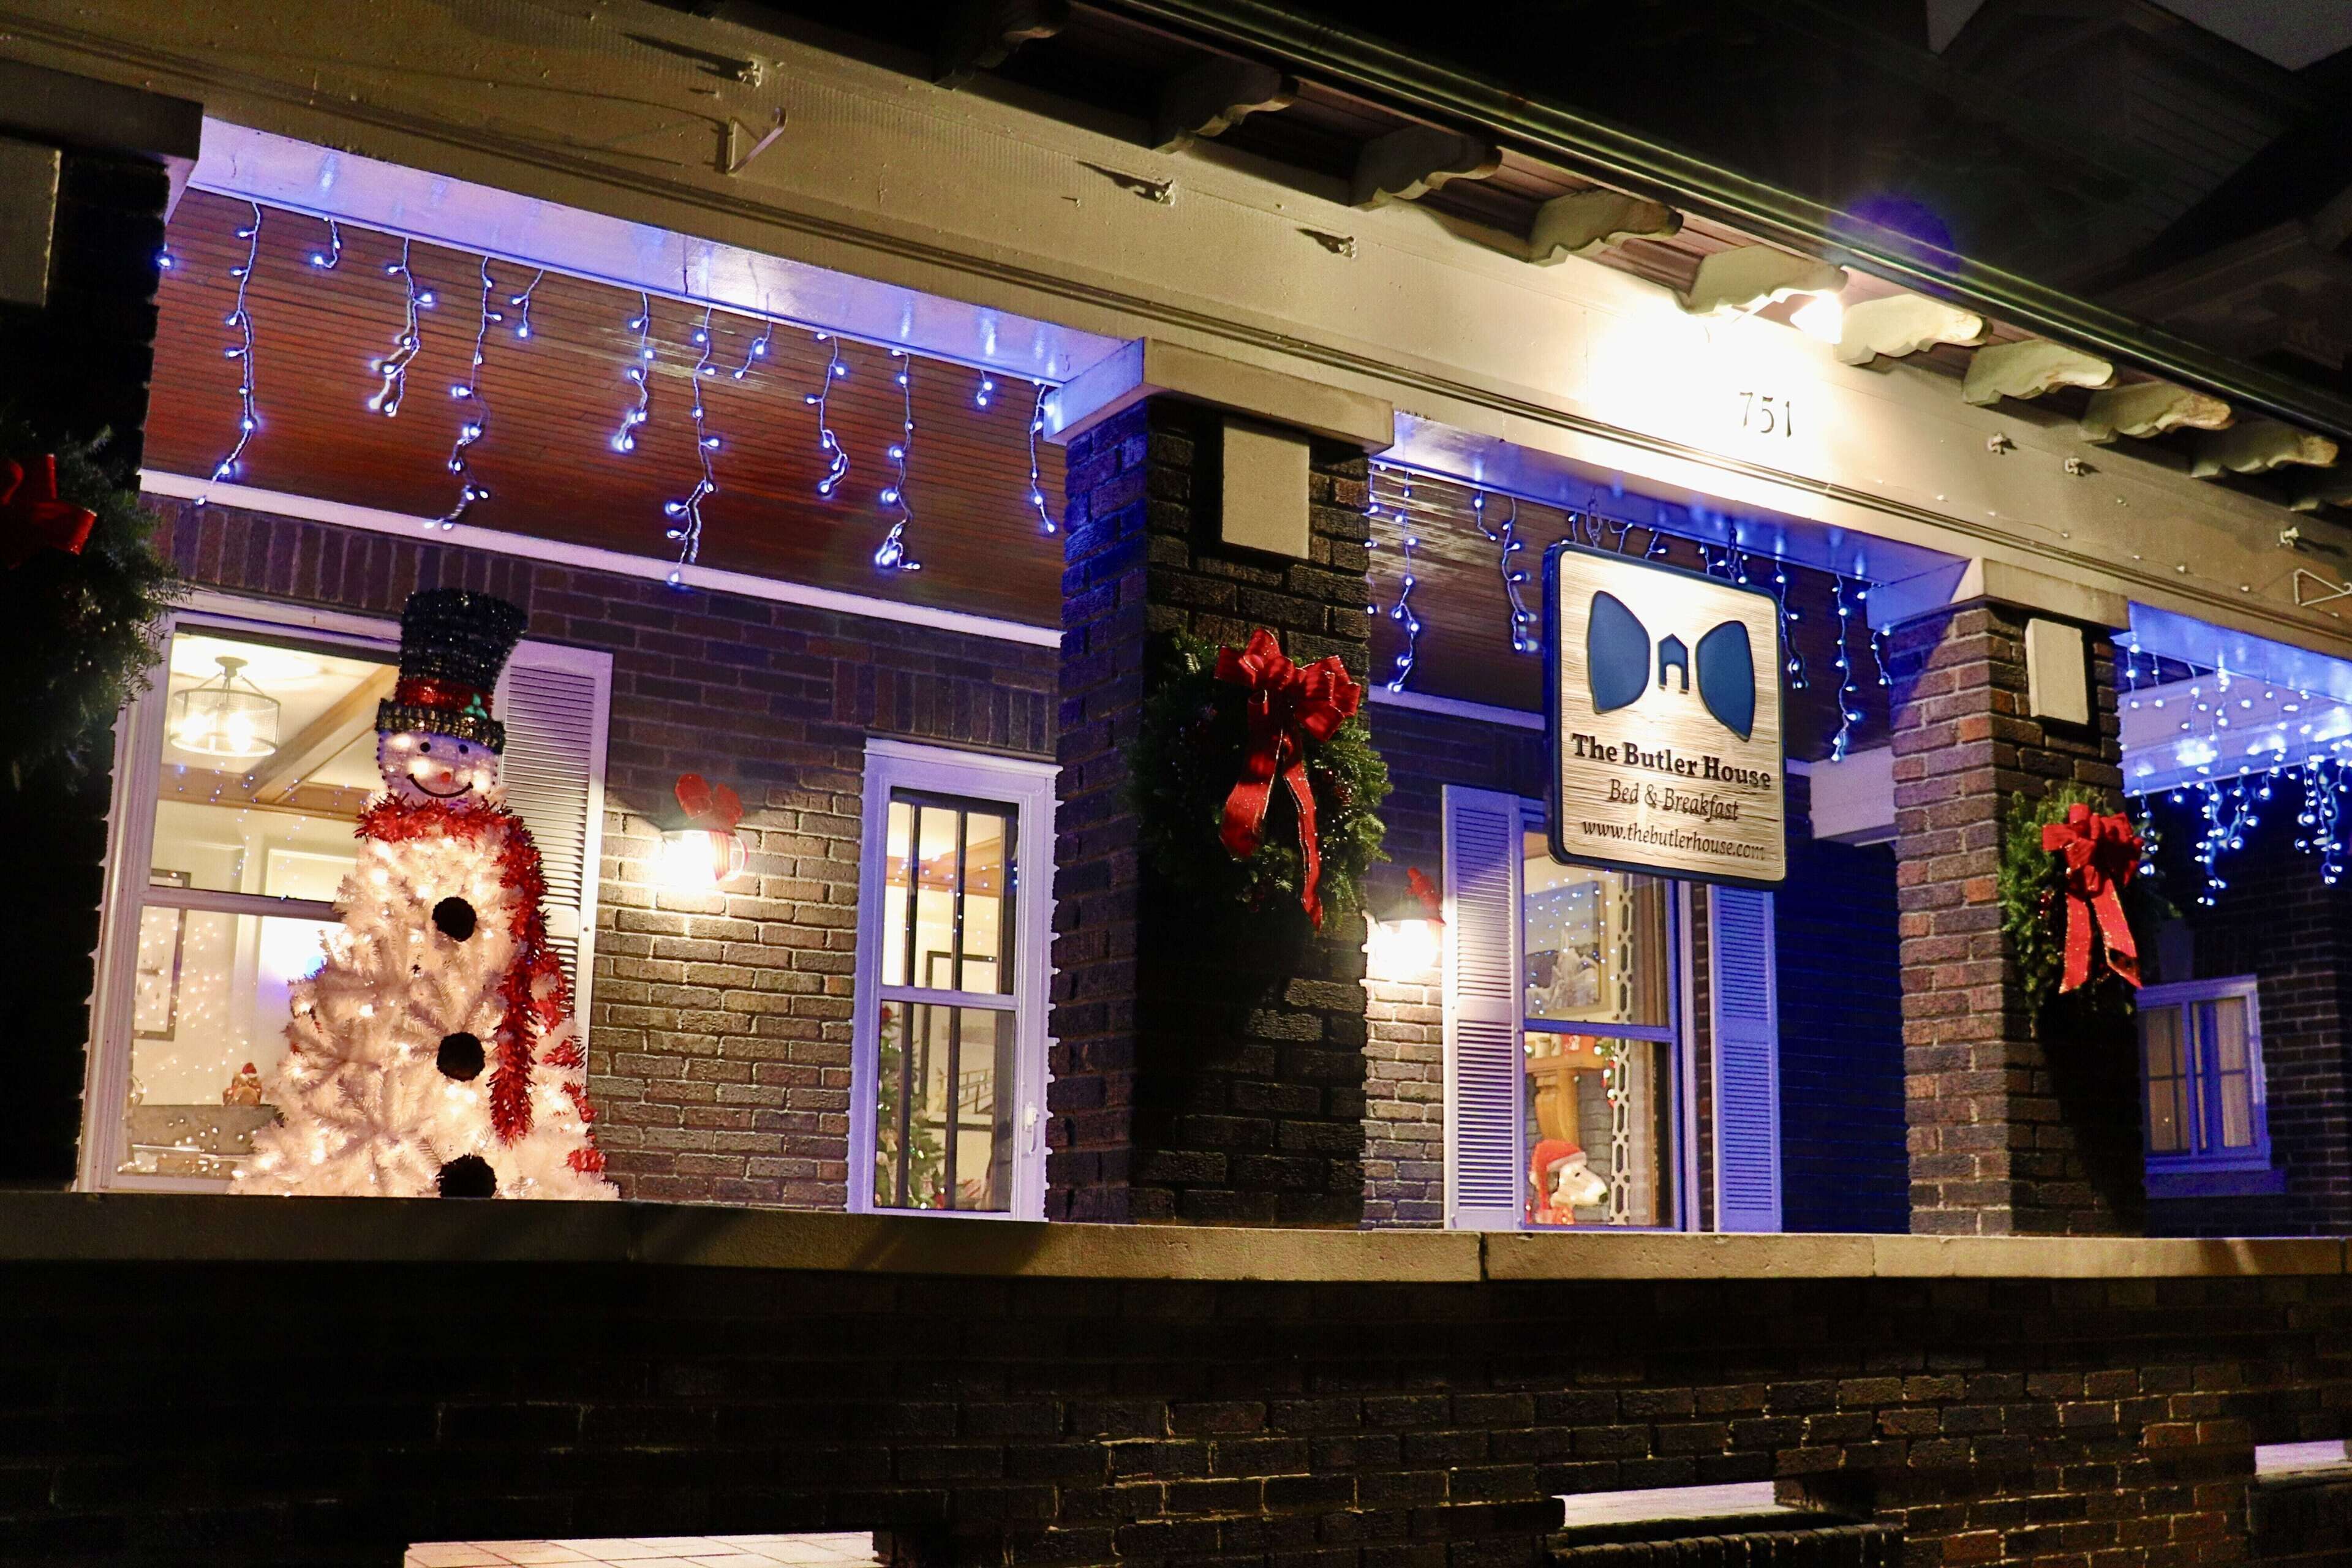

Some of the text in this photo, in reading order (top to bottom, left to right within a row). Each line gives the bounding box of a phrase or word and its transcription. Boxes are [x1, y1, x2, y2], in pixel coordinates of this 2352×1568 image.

[1740, 391, 1792, 438] 751
[1571, 733, 1771, 790] The Butler House
[1608, 778, 1740, 822] Bed & Breakfast
[1581, 821, 1765, 861] www.thebutlerhouse.com
